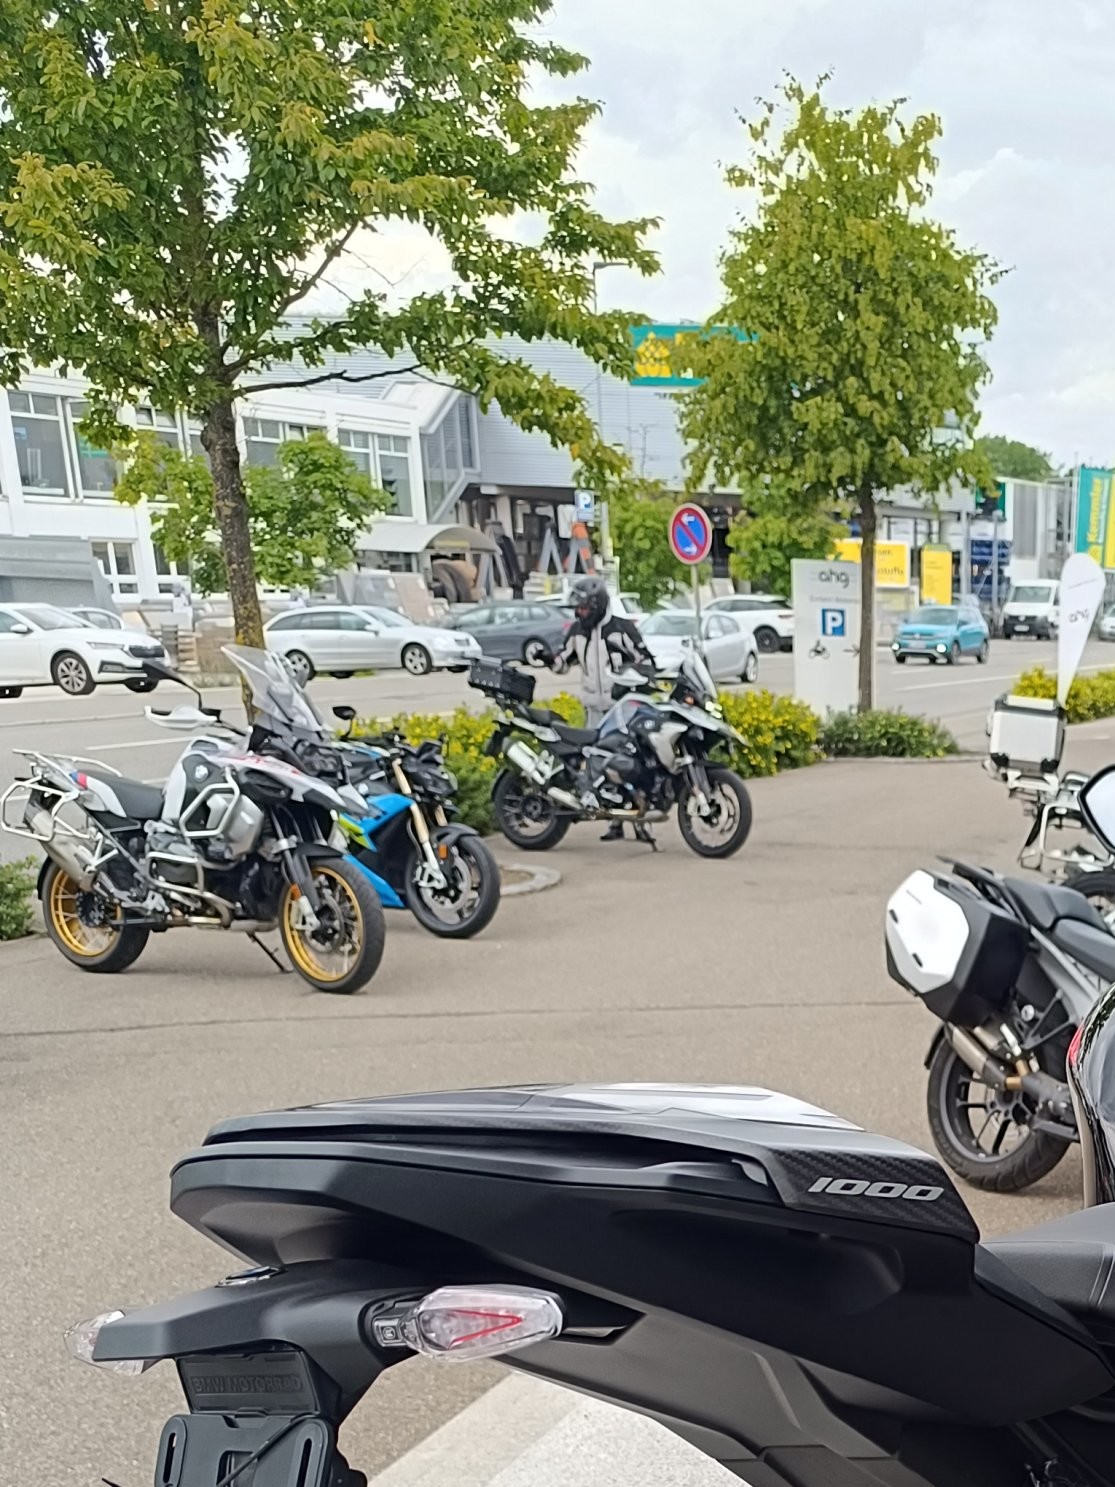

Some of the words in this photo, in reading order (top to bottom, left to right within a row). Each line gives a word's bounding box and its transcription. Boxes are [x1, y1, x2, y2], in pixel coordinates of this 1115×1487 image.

[818, 568, 850, 588] ahg
[824, 611, 844, 636] P
[808, 1177, 944, 1201] 1000
[191, 1375, 225, 1393] BMW
[228, 1374, 304, 1393] MOTORRAD
